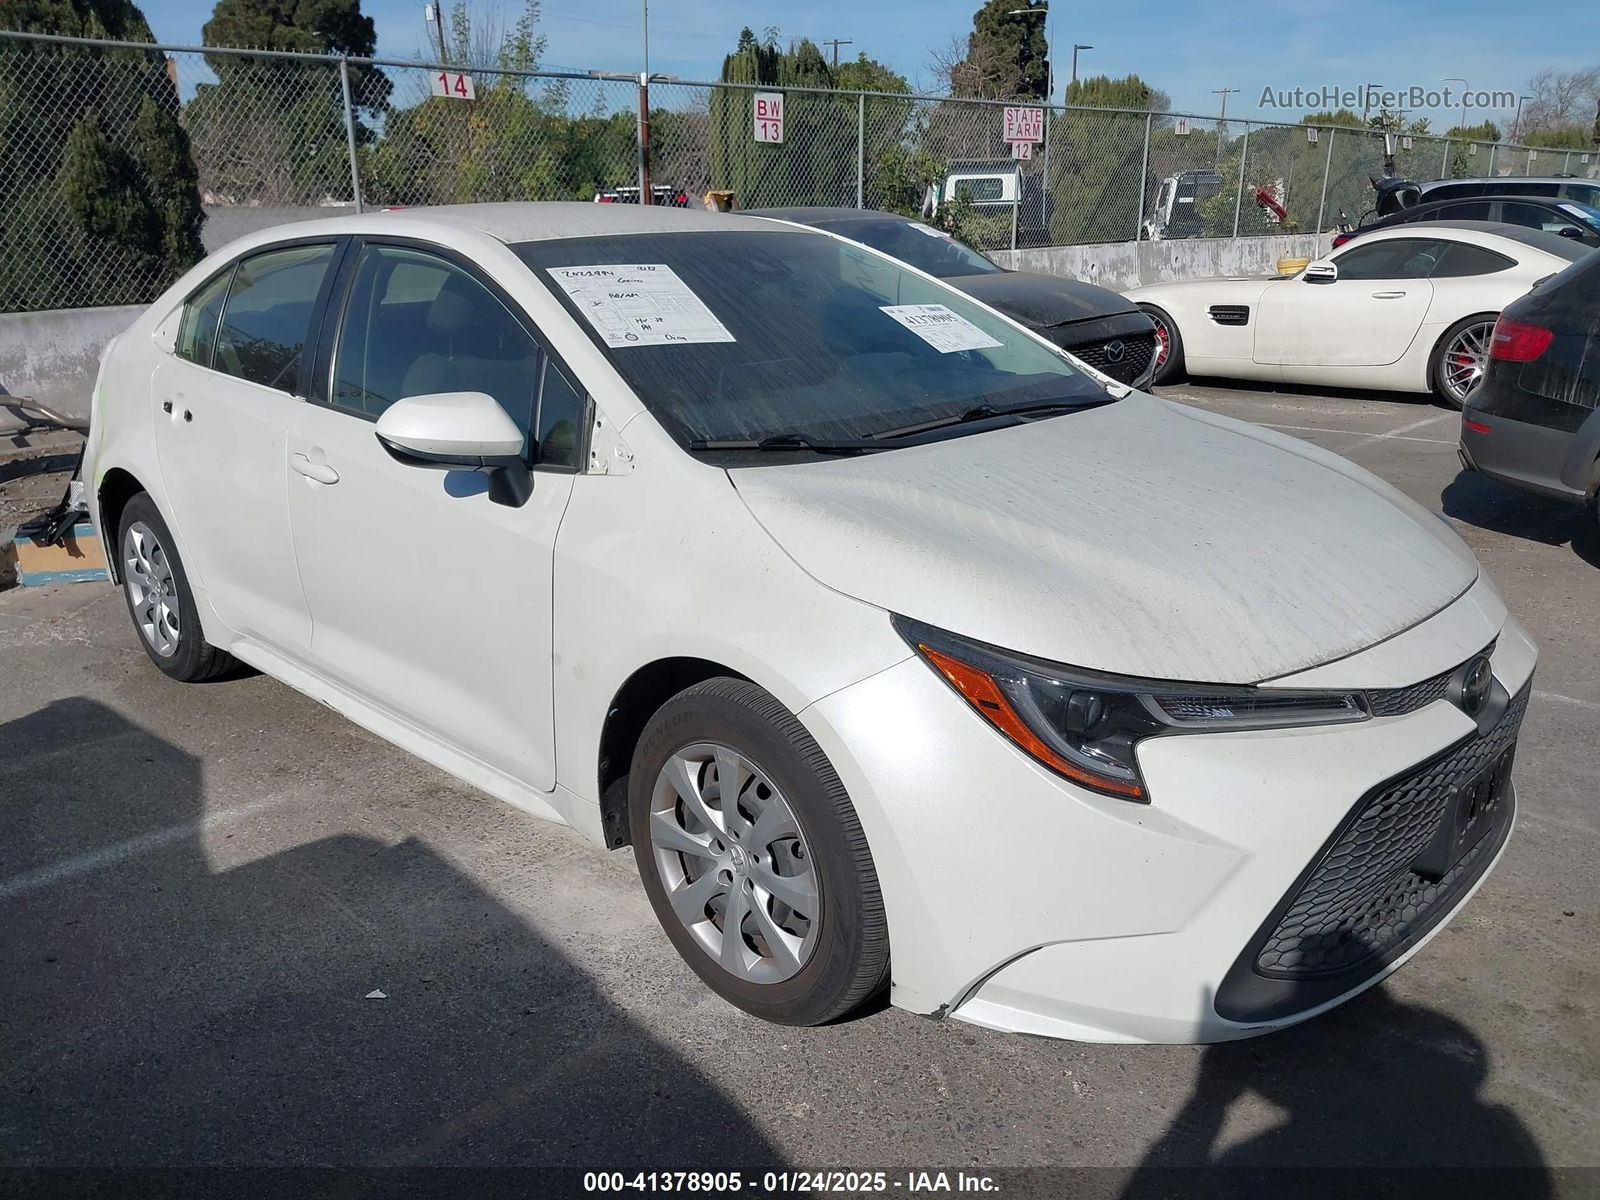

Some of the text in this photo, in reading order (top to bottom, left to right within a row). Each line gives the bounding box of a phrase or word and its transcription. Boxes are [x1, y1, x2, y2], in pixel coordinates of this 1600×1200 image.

[438, 71, 468, 97] 14
[757, 99, 781, 117] BW
[1006, 108, 1042, 122] STATE
[761, 121, 780, 141] 13
[1007, 122, 1040, 137] FARM
[1015, 142, 1029, 158] 12
